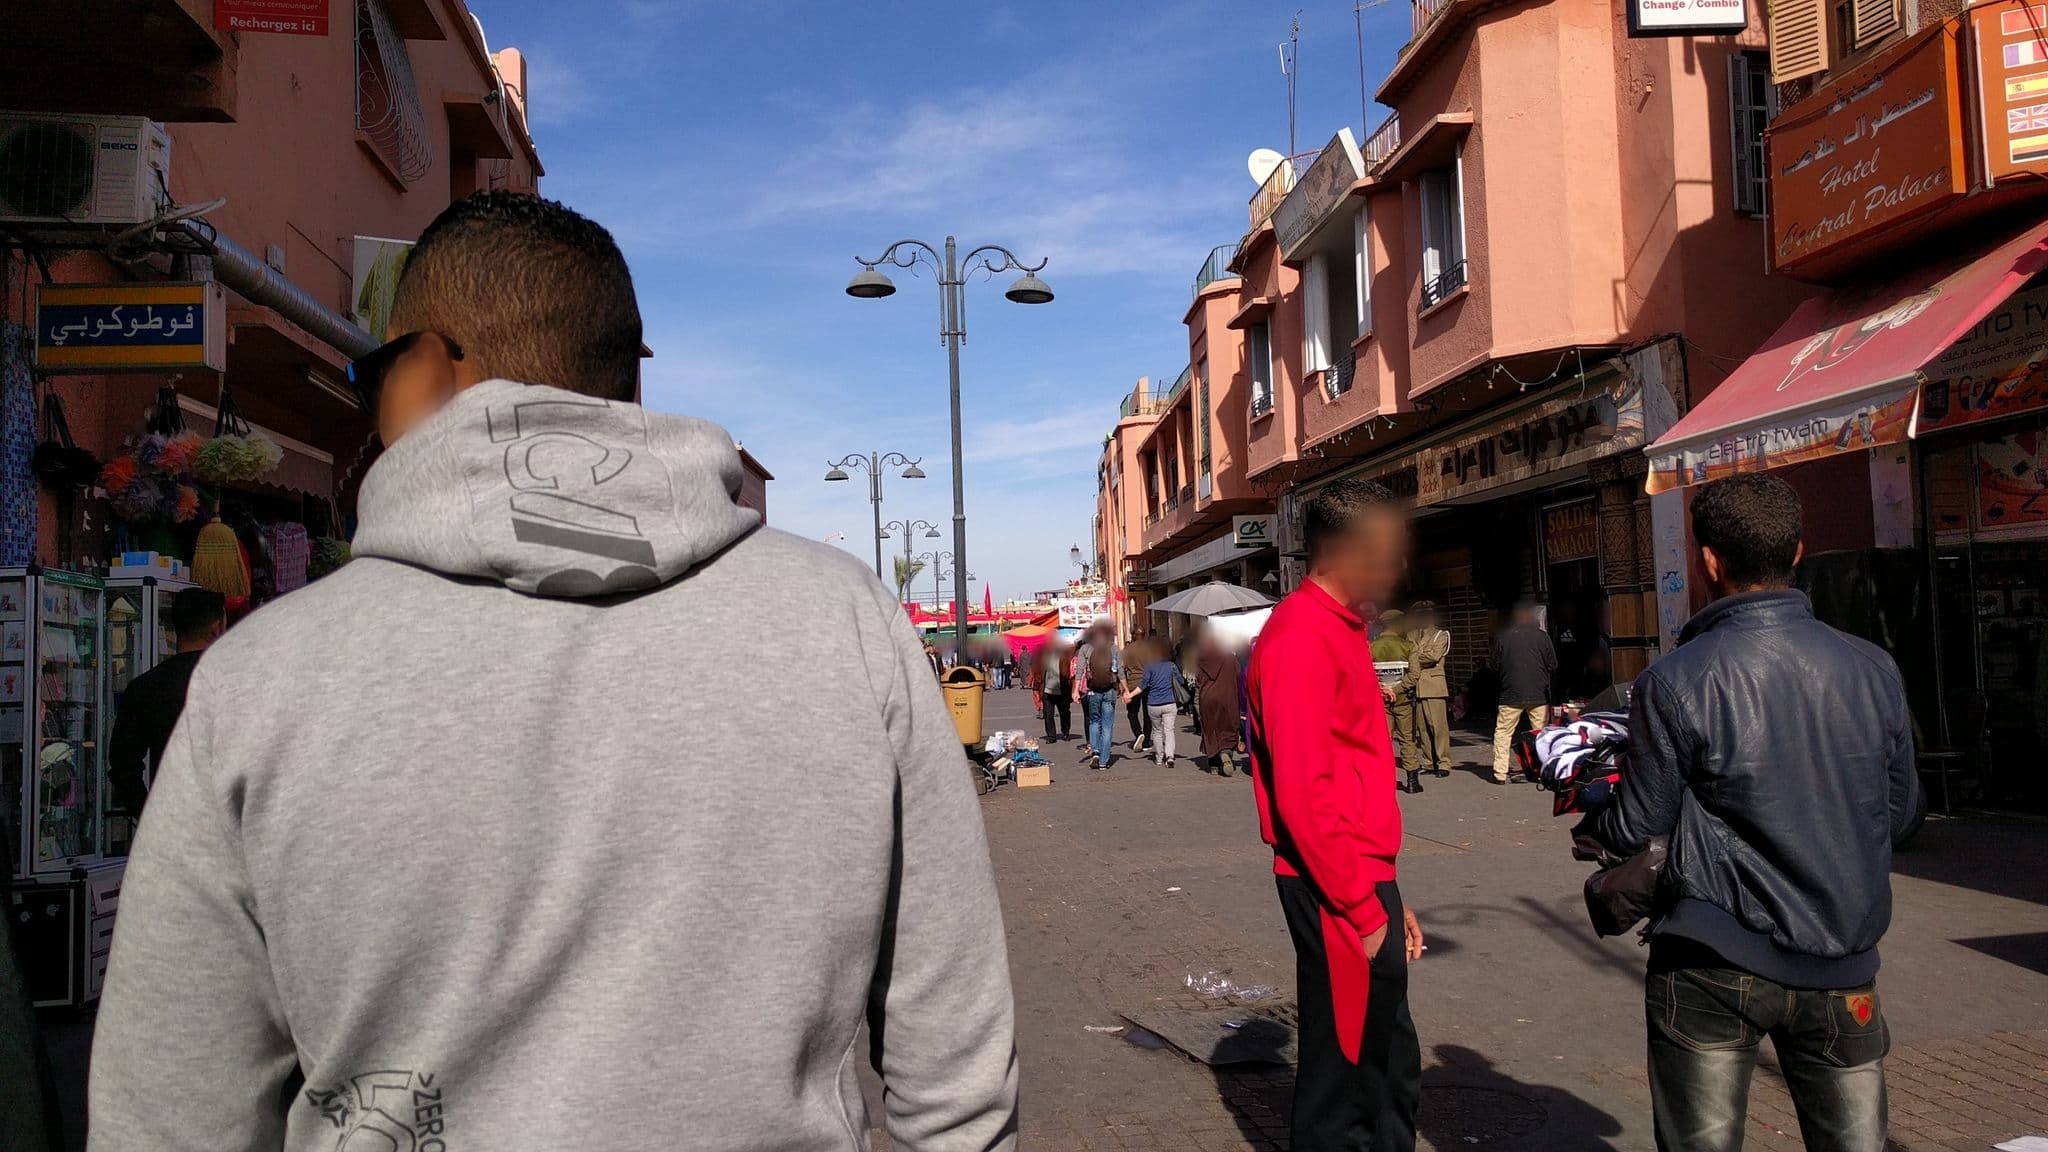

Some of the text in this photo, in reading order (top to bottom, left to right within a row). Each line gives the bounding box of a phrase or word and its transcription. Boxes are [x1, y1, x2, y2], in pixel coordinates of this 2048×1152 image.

[230, 16, 315, 32] Rechargez ici
[1643, 0, 1686, 10] Change
[101, 142, 138, 151] BEKO
[1819, 147, 1881, 197] Hotel
[1779, 166, 1948, 257] Central Palace
[50, 304, 194, 346] فوطوكوبي
[1708, 434, 1768, 460] Electro
[1774, 418, 1829, 443] twam
